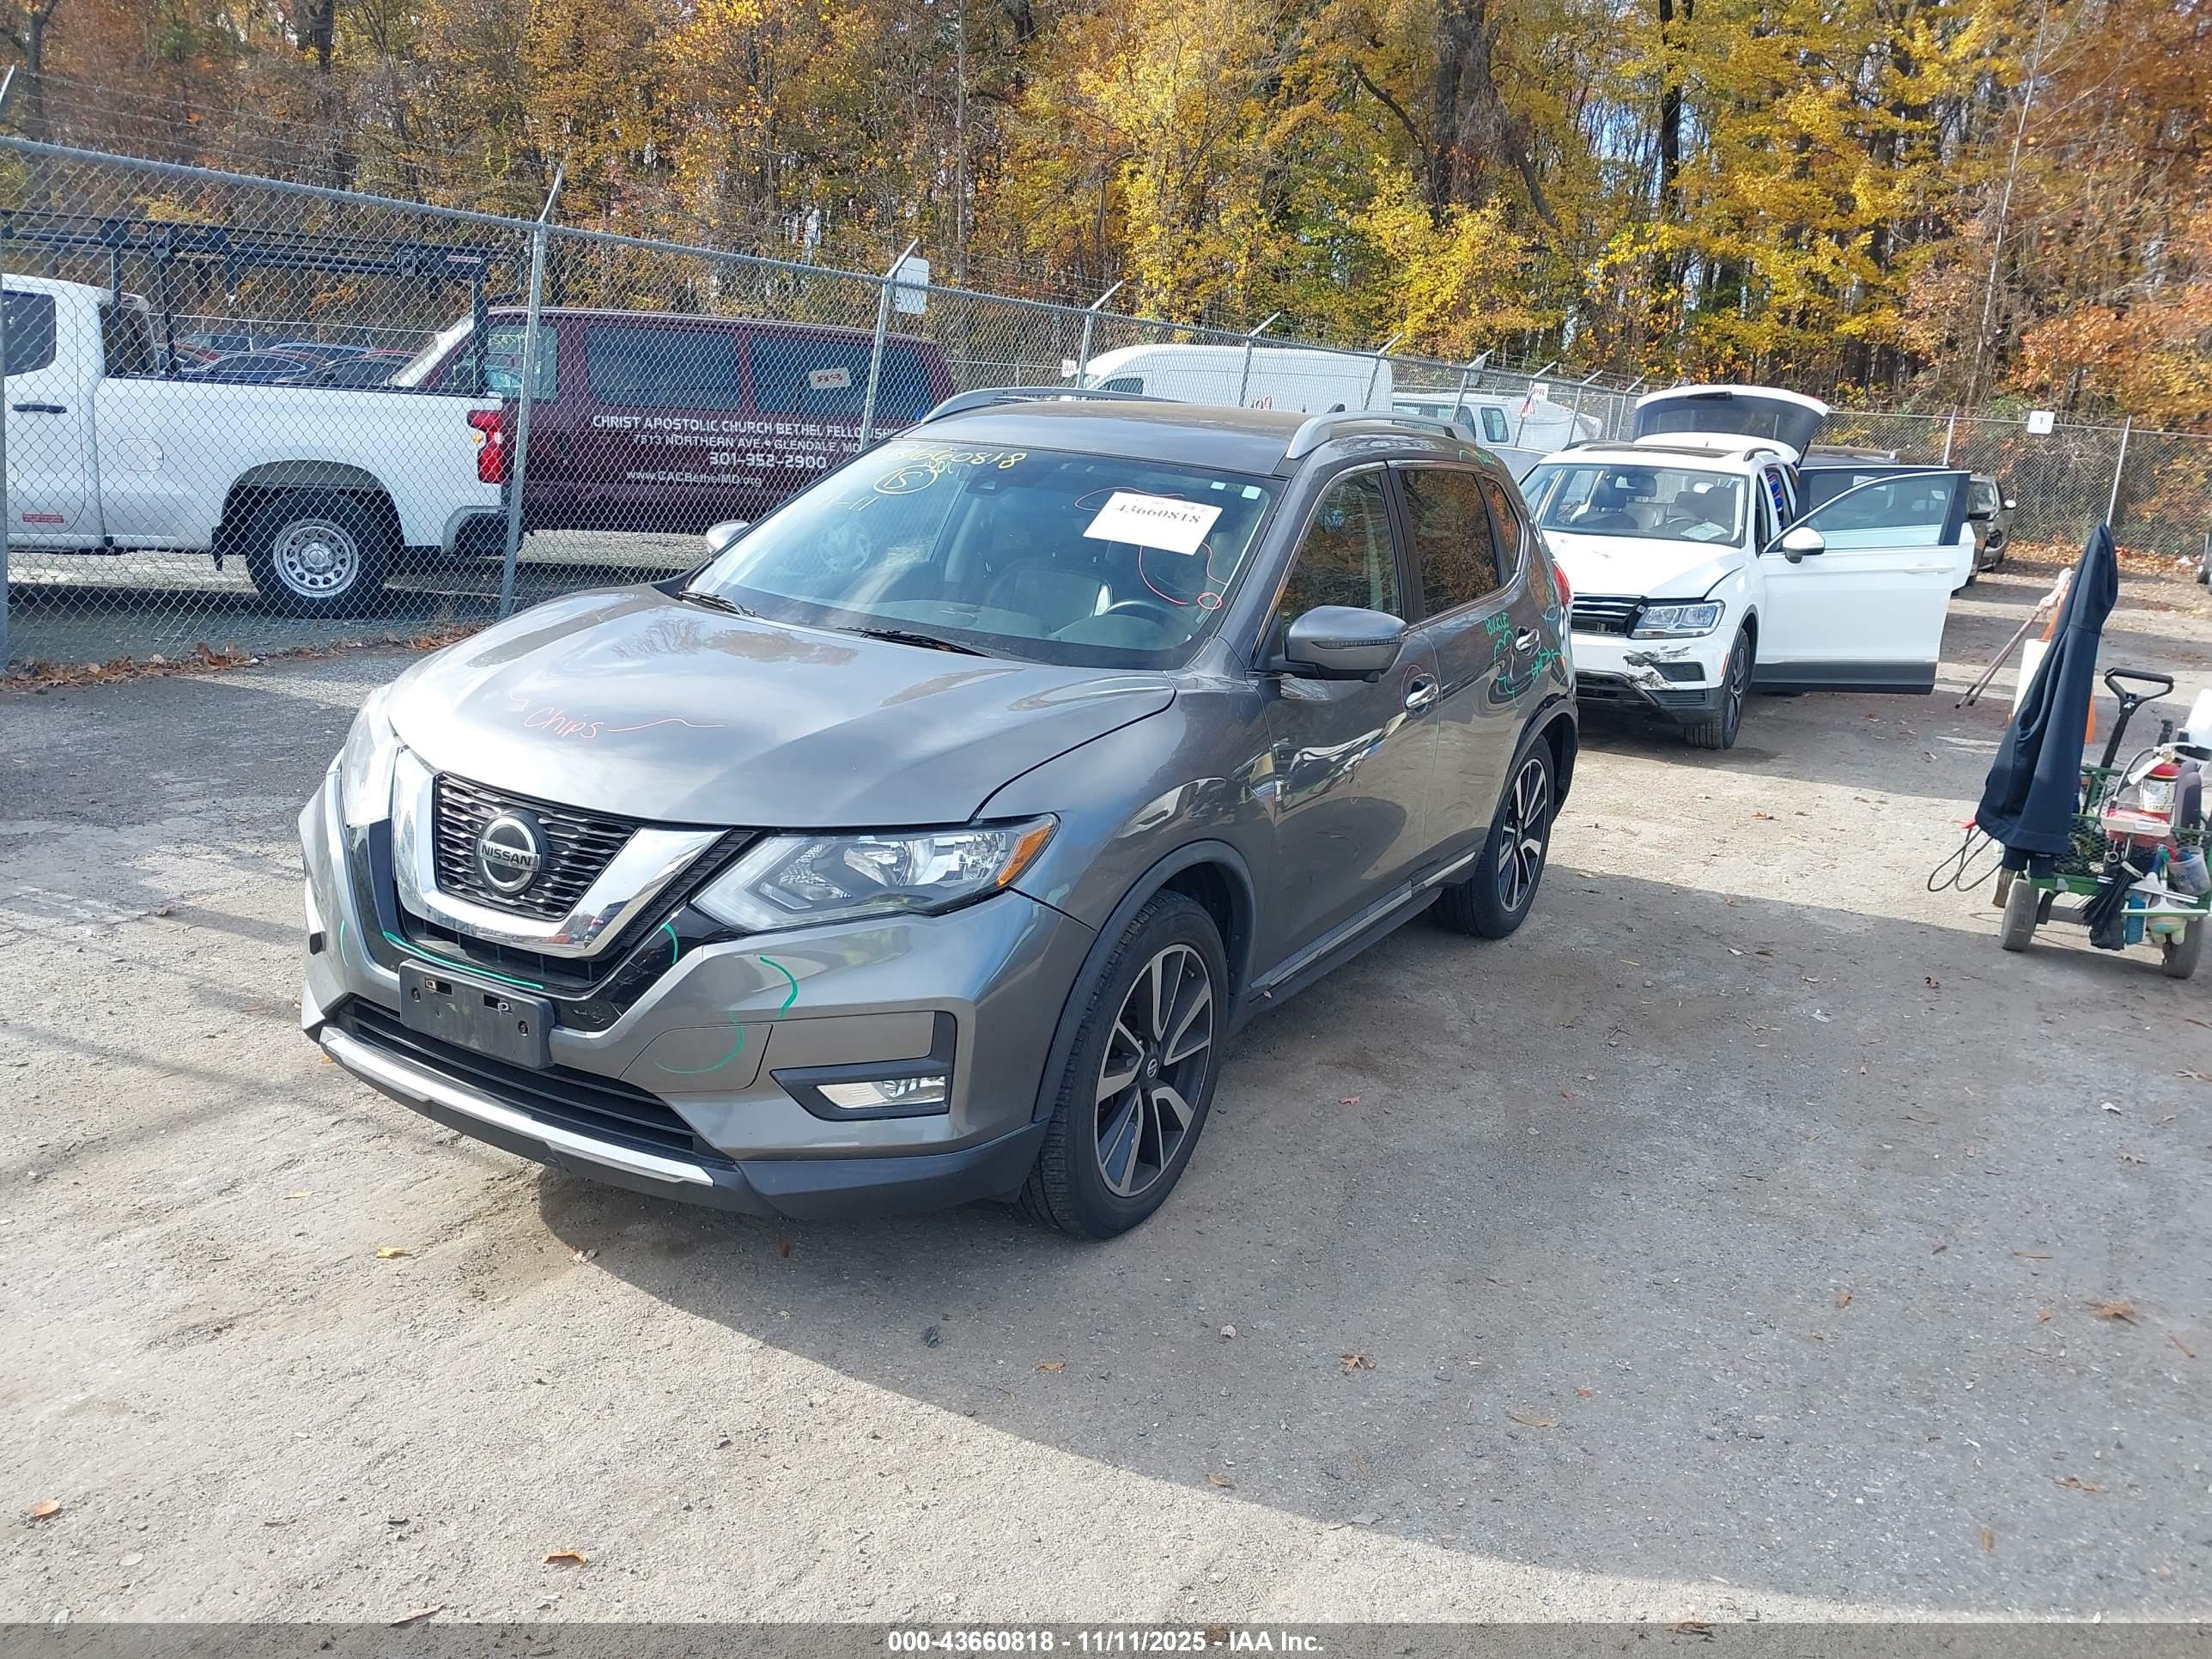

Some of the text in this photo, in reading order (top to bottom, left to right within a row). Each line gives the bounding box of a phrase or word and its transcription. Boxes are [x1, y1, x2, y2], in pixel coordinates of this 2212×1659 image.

[592, 416, 641, 428] CHRIST
[644, 417, 718, 432] APOSTOLIC
[721, 420, 773, 434] CHURCH
[775, 422, 823, 435] BETHEL
[665, 434, 734, 447] NORTHERN
[709, 452, 827, 469] 301-352-2900
[627, 471, 762, 488] www.CACBethelMD.org
[481, 844, 532, 866] NISSAN
